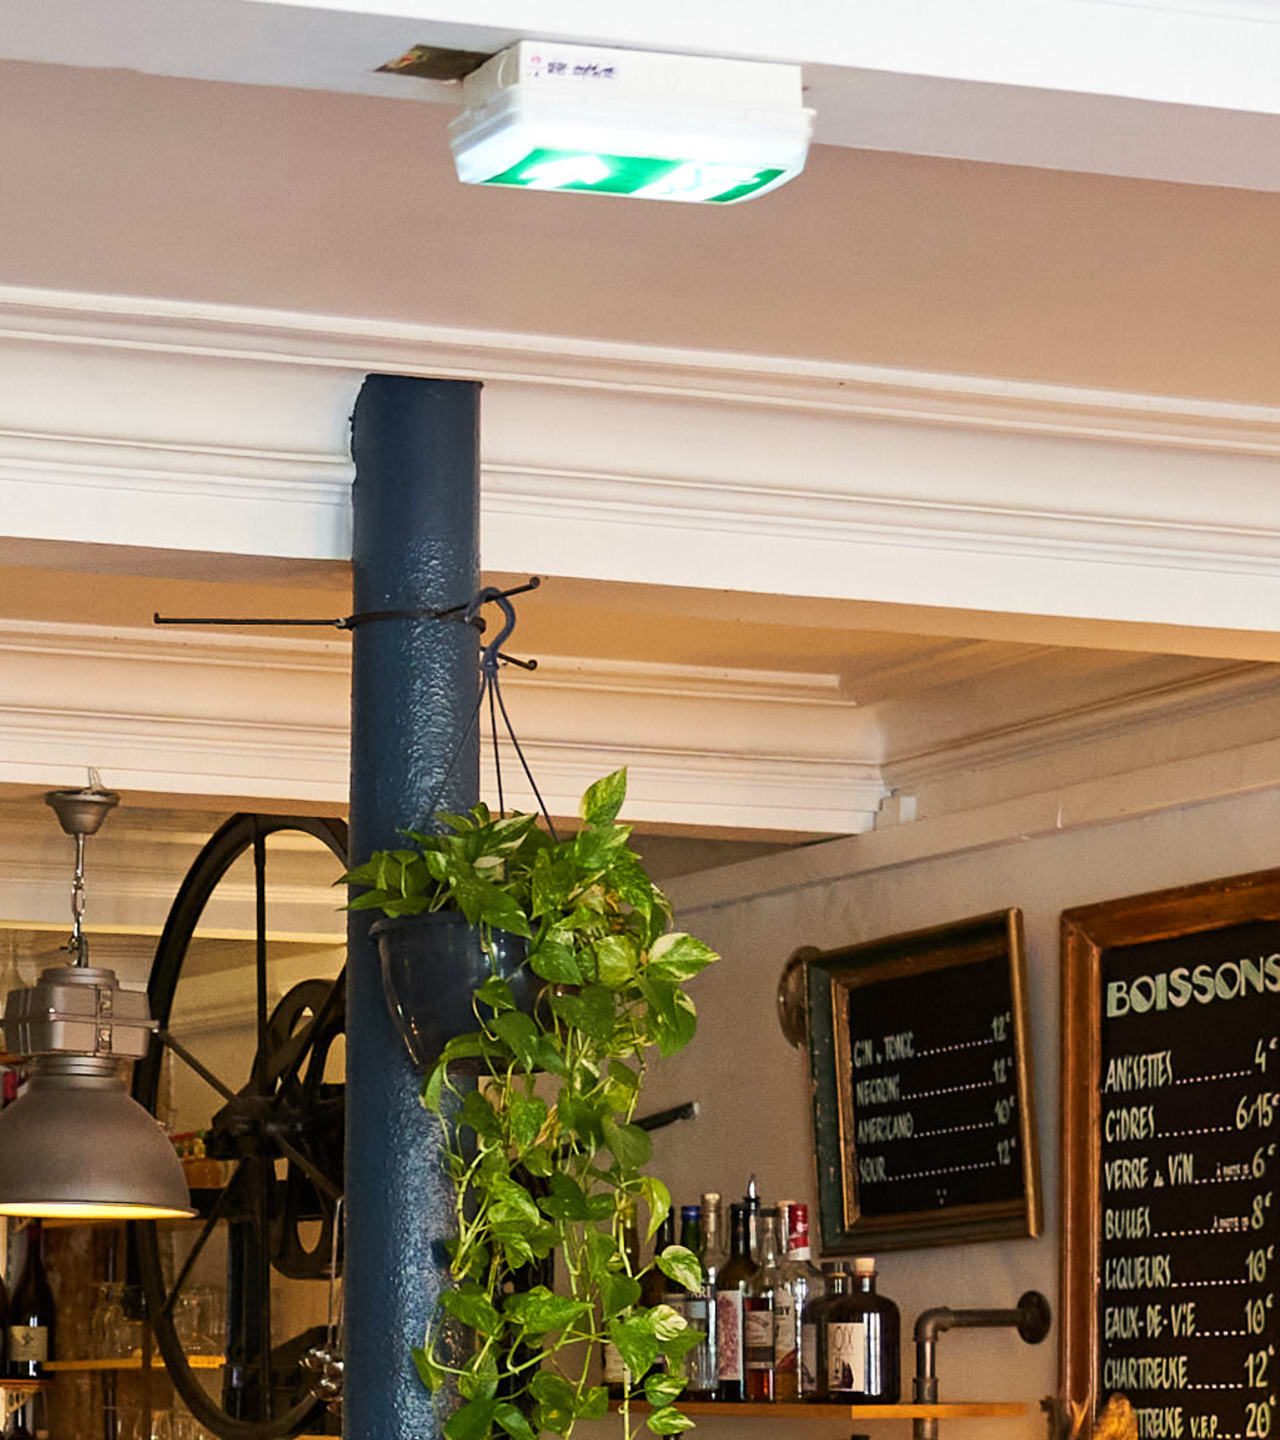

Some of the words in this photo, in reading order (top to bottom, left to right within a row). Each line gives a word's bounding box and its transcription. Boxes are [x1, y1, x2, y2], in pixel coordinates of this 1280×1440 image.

[1106, 953, 1280, 1018] BOISSONS
[883, 1031, 915, 1061] TONIC
[1104, 1050, 1173, 1094] ANISETTES
[857, 1112, 914, 1144] AMERICANO
[1105, 1104, 1155, 1143] CIDRES
[859, 1156, 887, 1183] SOUR
[1104, 1156, 1149, 1192] VERRE
[1168, 1152, 1194, 1187] VIN
[1105, 1206, 1151, 1241] BULLES
[1105, 1254, 1172, 1290] LIQUEURS
[1104, 1355, 1188, 1390] CHARTREUSE
[1133, 1406, 1184, 1439] TREUSE
